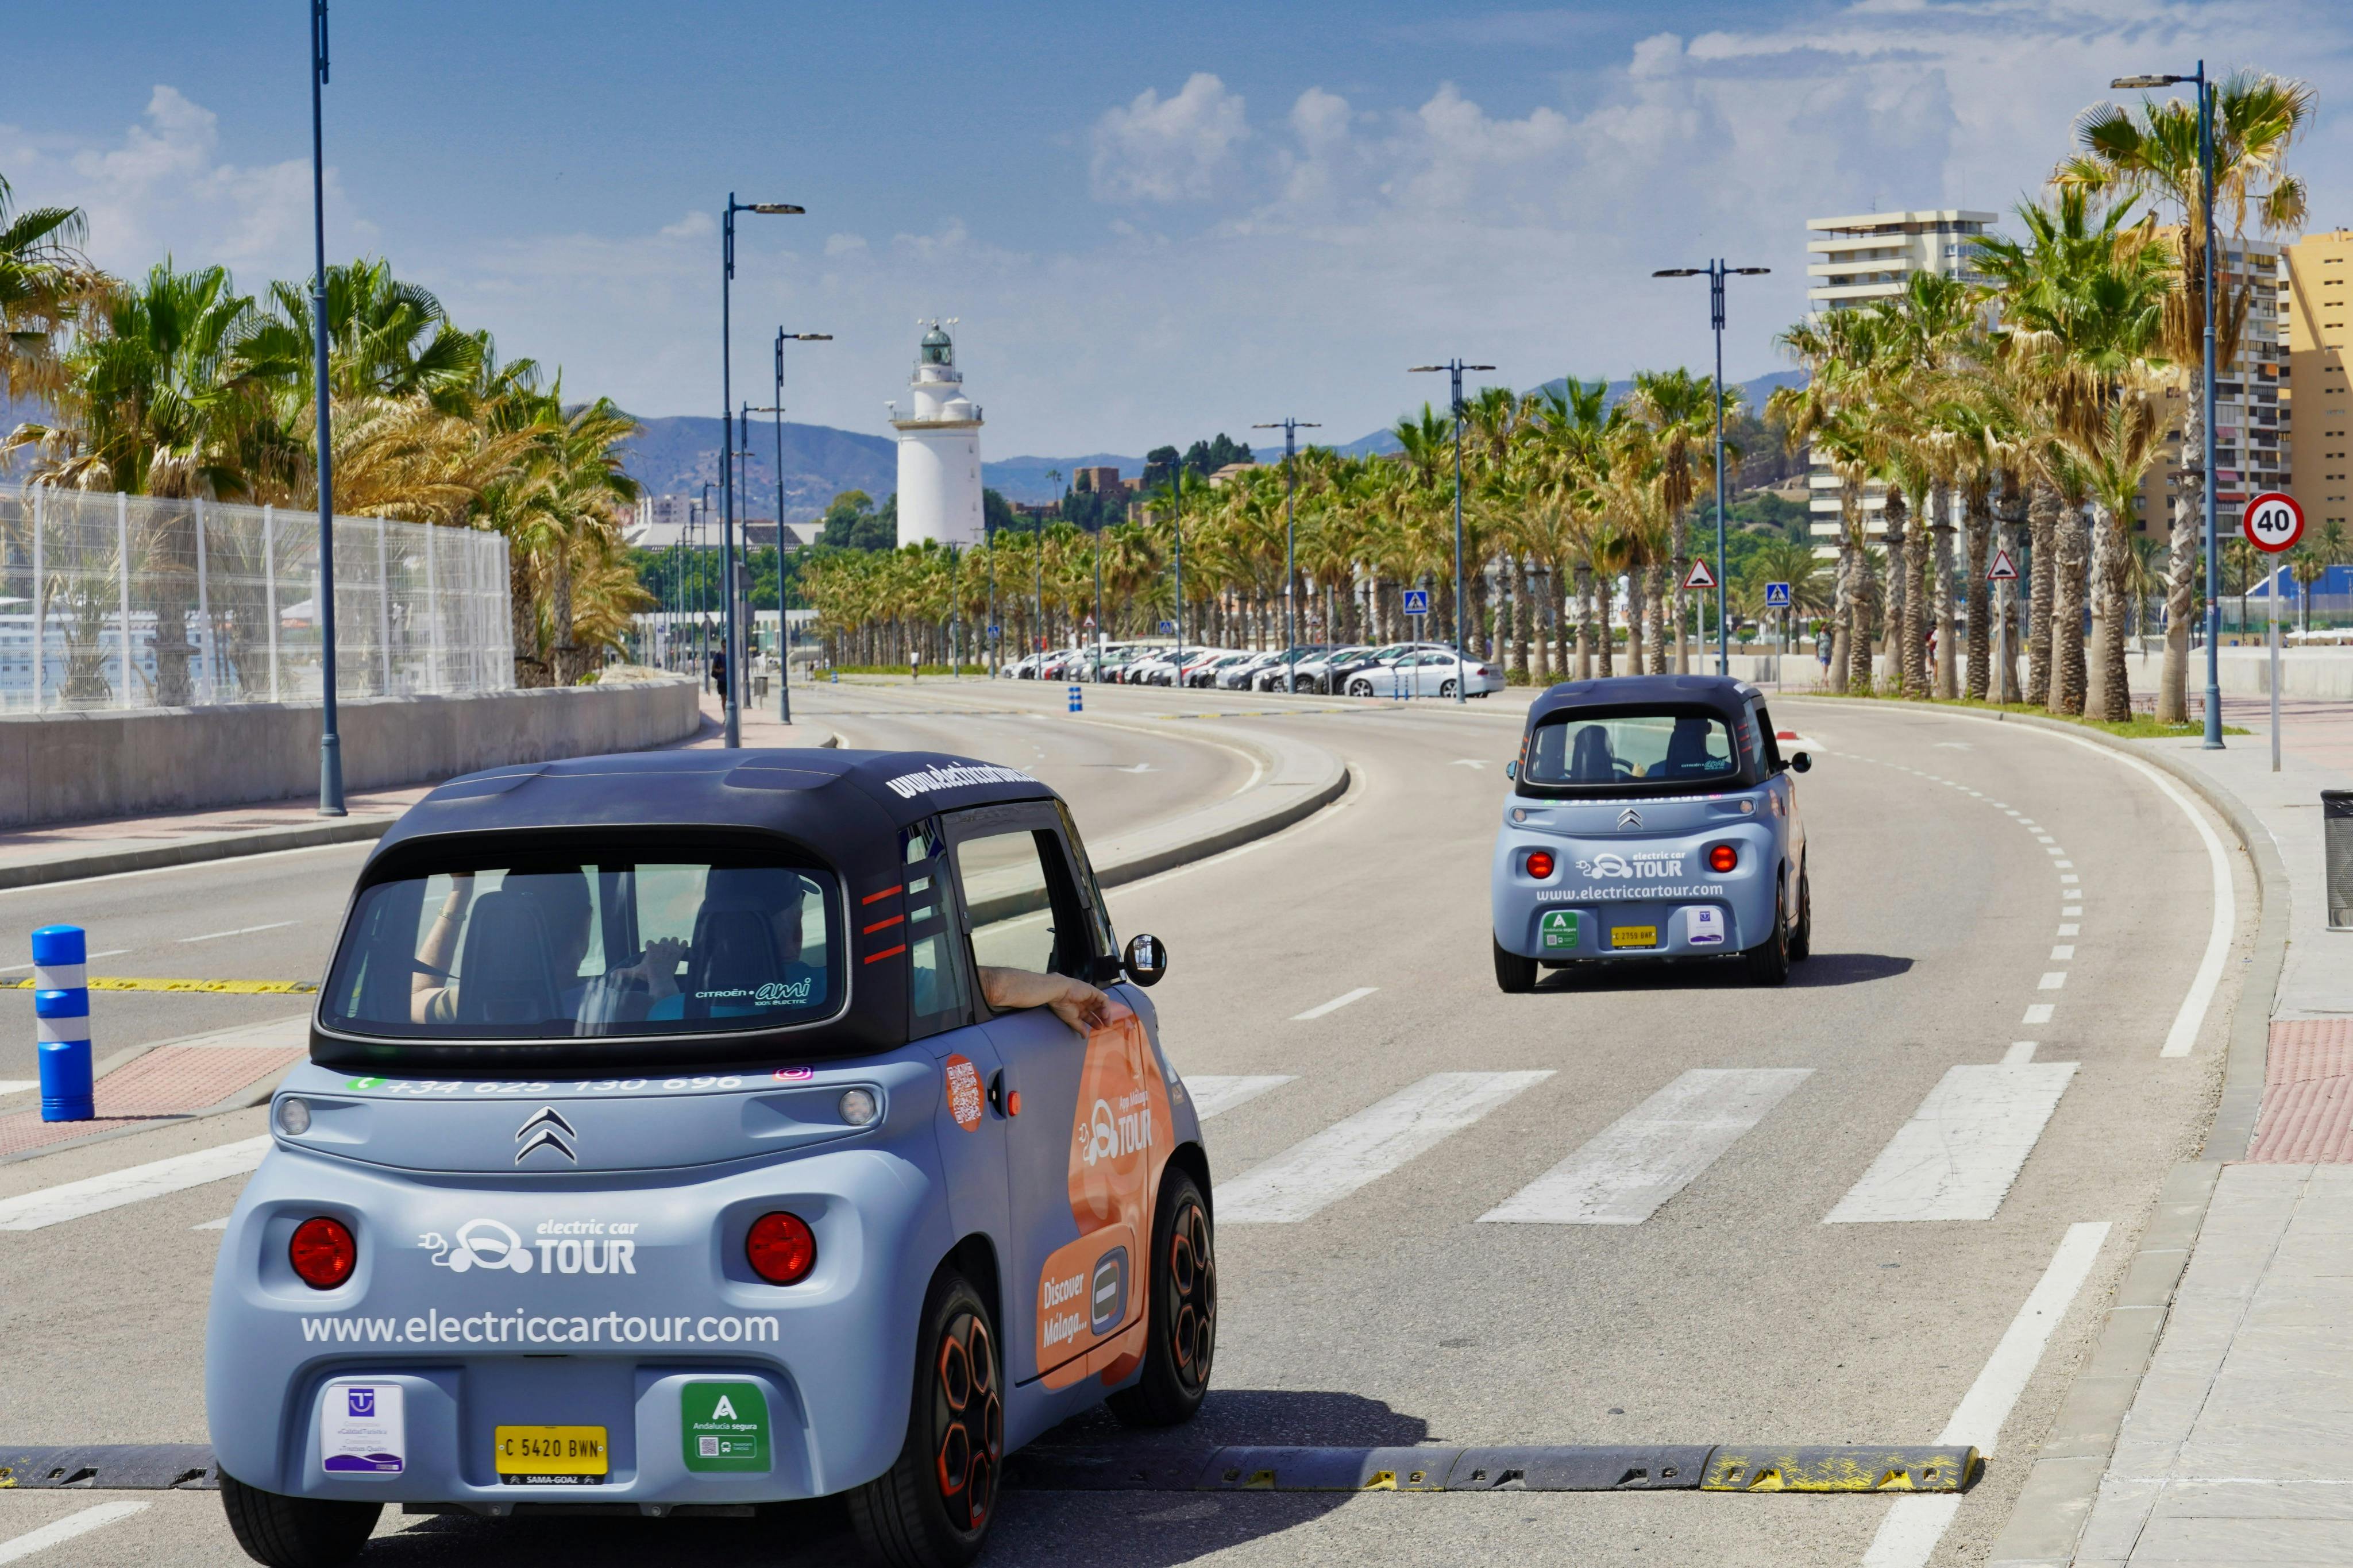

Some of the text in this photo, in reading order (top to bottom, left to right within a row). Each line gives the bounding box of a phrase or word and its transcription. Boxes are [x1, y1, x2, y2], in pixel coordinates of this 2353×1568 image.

[2258, 509, 2290, 532] 40
[1633, 851, 1669, 860] electric
[1633, 860, 1683, 878] TOUR
[1536, 885, 1723, 901] www.electriccartour.com
[755, 978, 811, 1000] ami
[1118, 1109, 1152, 1156] TOUR
[537, 1218, 639, 1234] electric car
[535, 1239, 637, 1274] TOUR
[1044, 1273, 1084, 1310] Discover
[301, 1308, 779, 1342] www.electriccartour.com
[506, 1439, 598, 1457] C 5420 BWN
